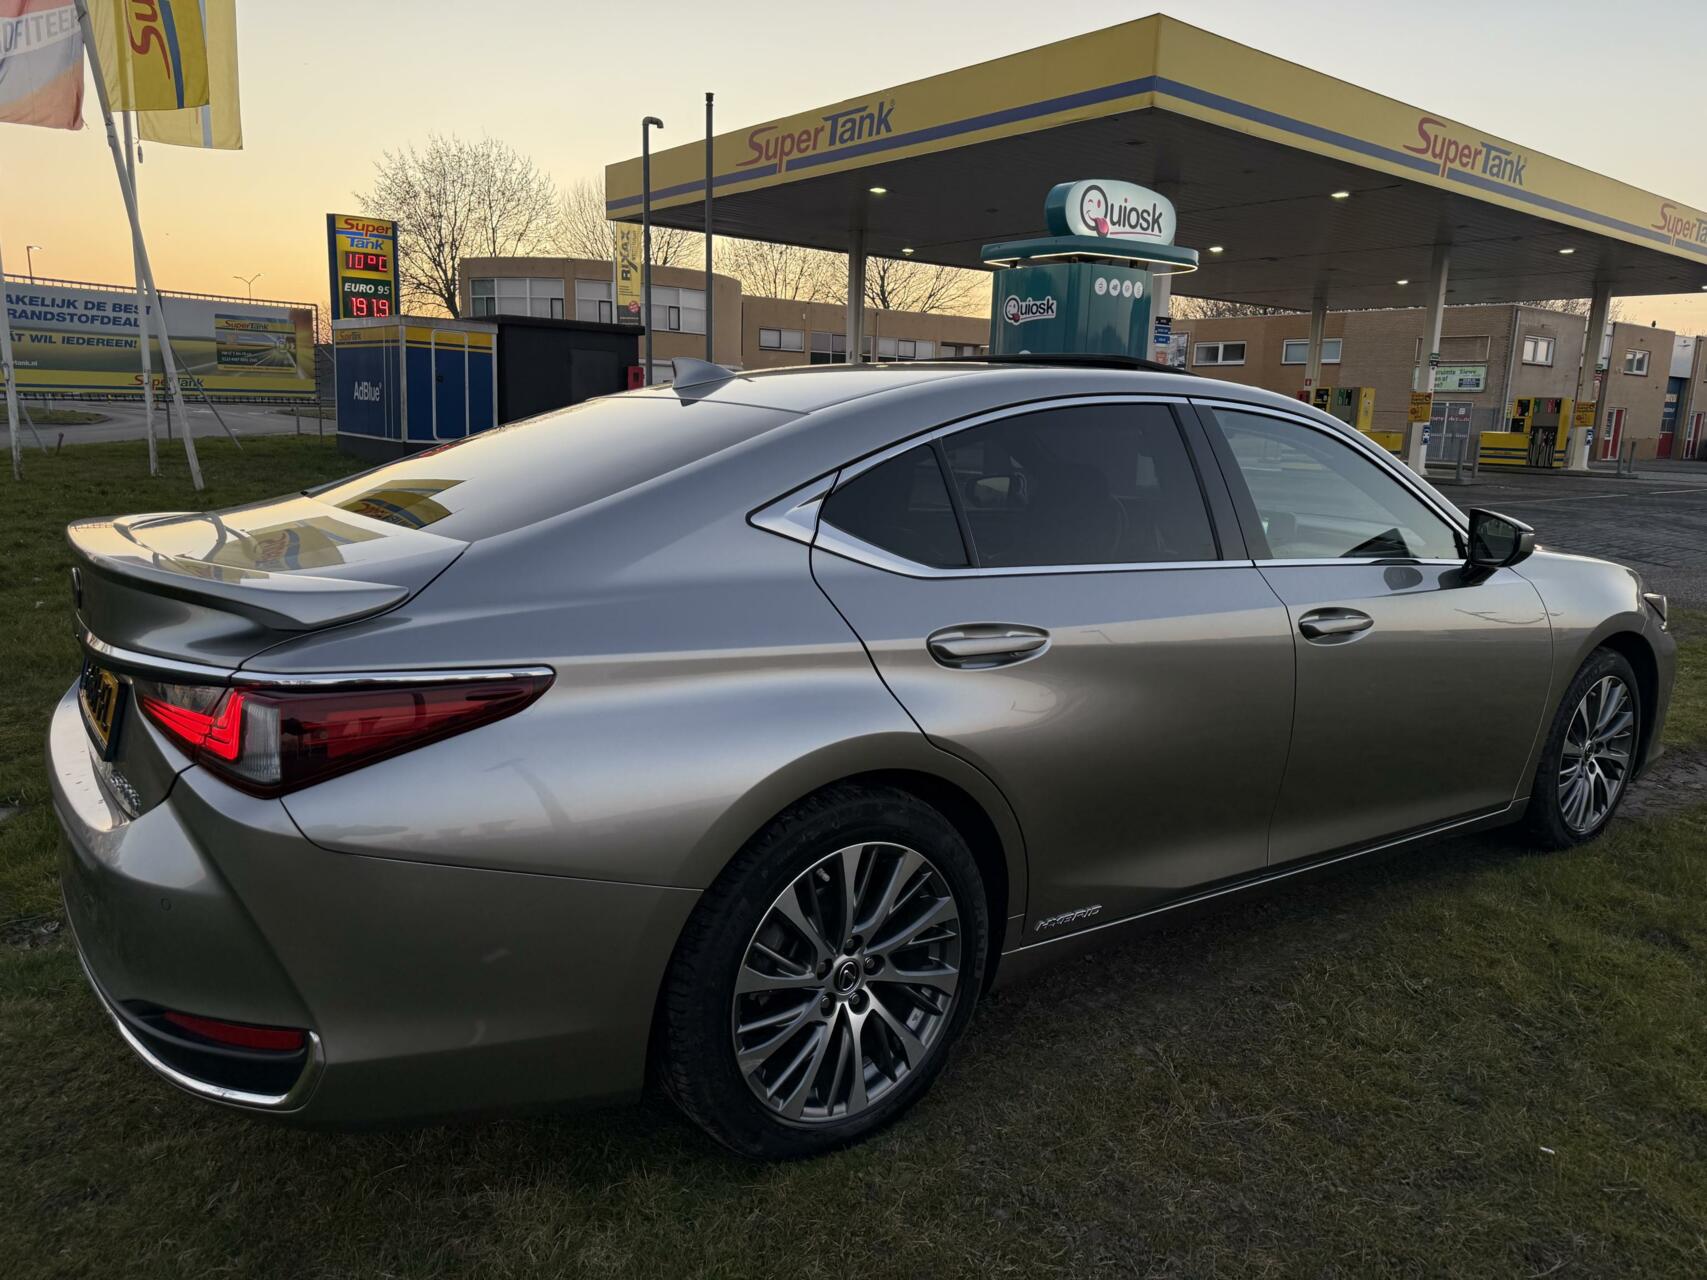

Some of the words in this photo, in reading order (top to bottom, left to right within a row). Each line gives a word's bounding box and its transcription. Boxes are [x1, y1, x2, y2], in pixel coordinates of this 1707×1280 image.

[736, 100, 894, 173] SuperTank
[1402, 116, 1527, 186] SuperTank
[1080, 185, 1163, 236] Quiosk
[338, 217, 392, 237] Super
[346, 236, 384, 250] Tank
[344, 282, 375, 294] EURO
[377, 285, 390, 295] 95
[6, 294, 78, 310] AKELIJK
[84, 301, 108, 312] DE
[1005, 298, 1054, 321] Quiosk
[7, 308, 140, 328] RANDSTOFDEAL
[30, 333, 57, 344] WIL
[62, 335, 137, 349] IEDEREEN!
[353, 381, 381, 402] AdBlue
[1034, 905, 1102, 931] HYBRID
